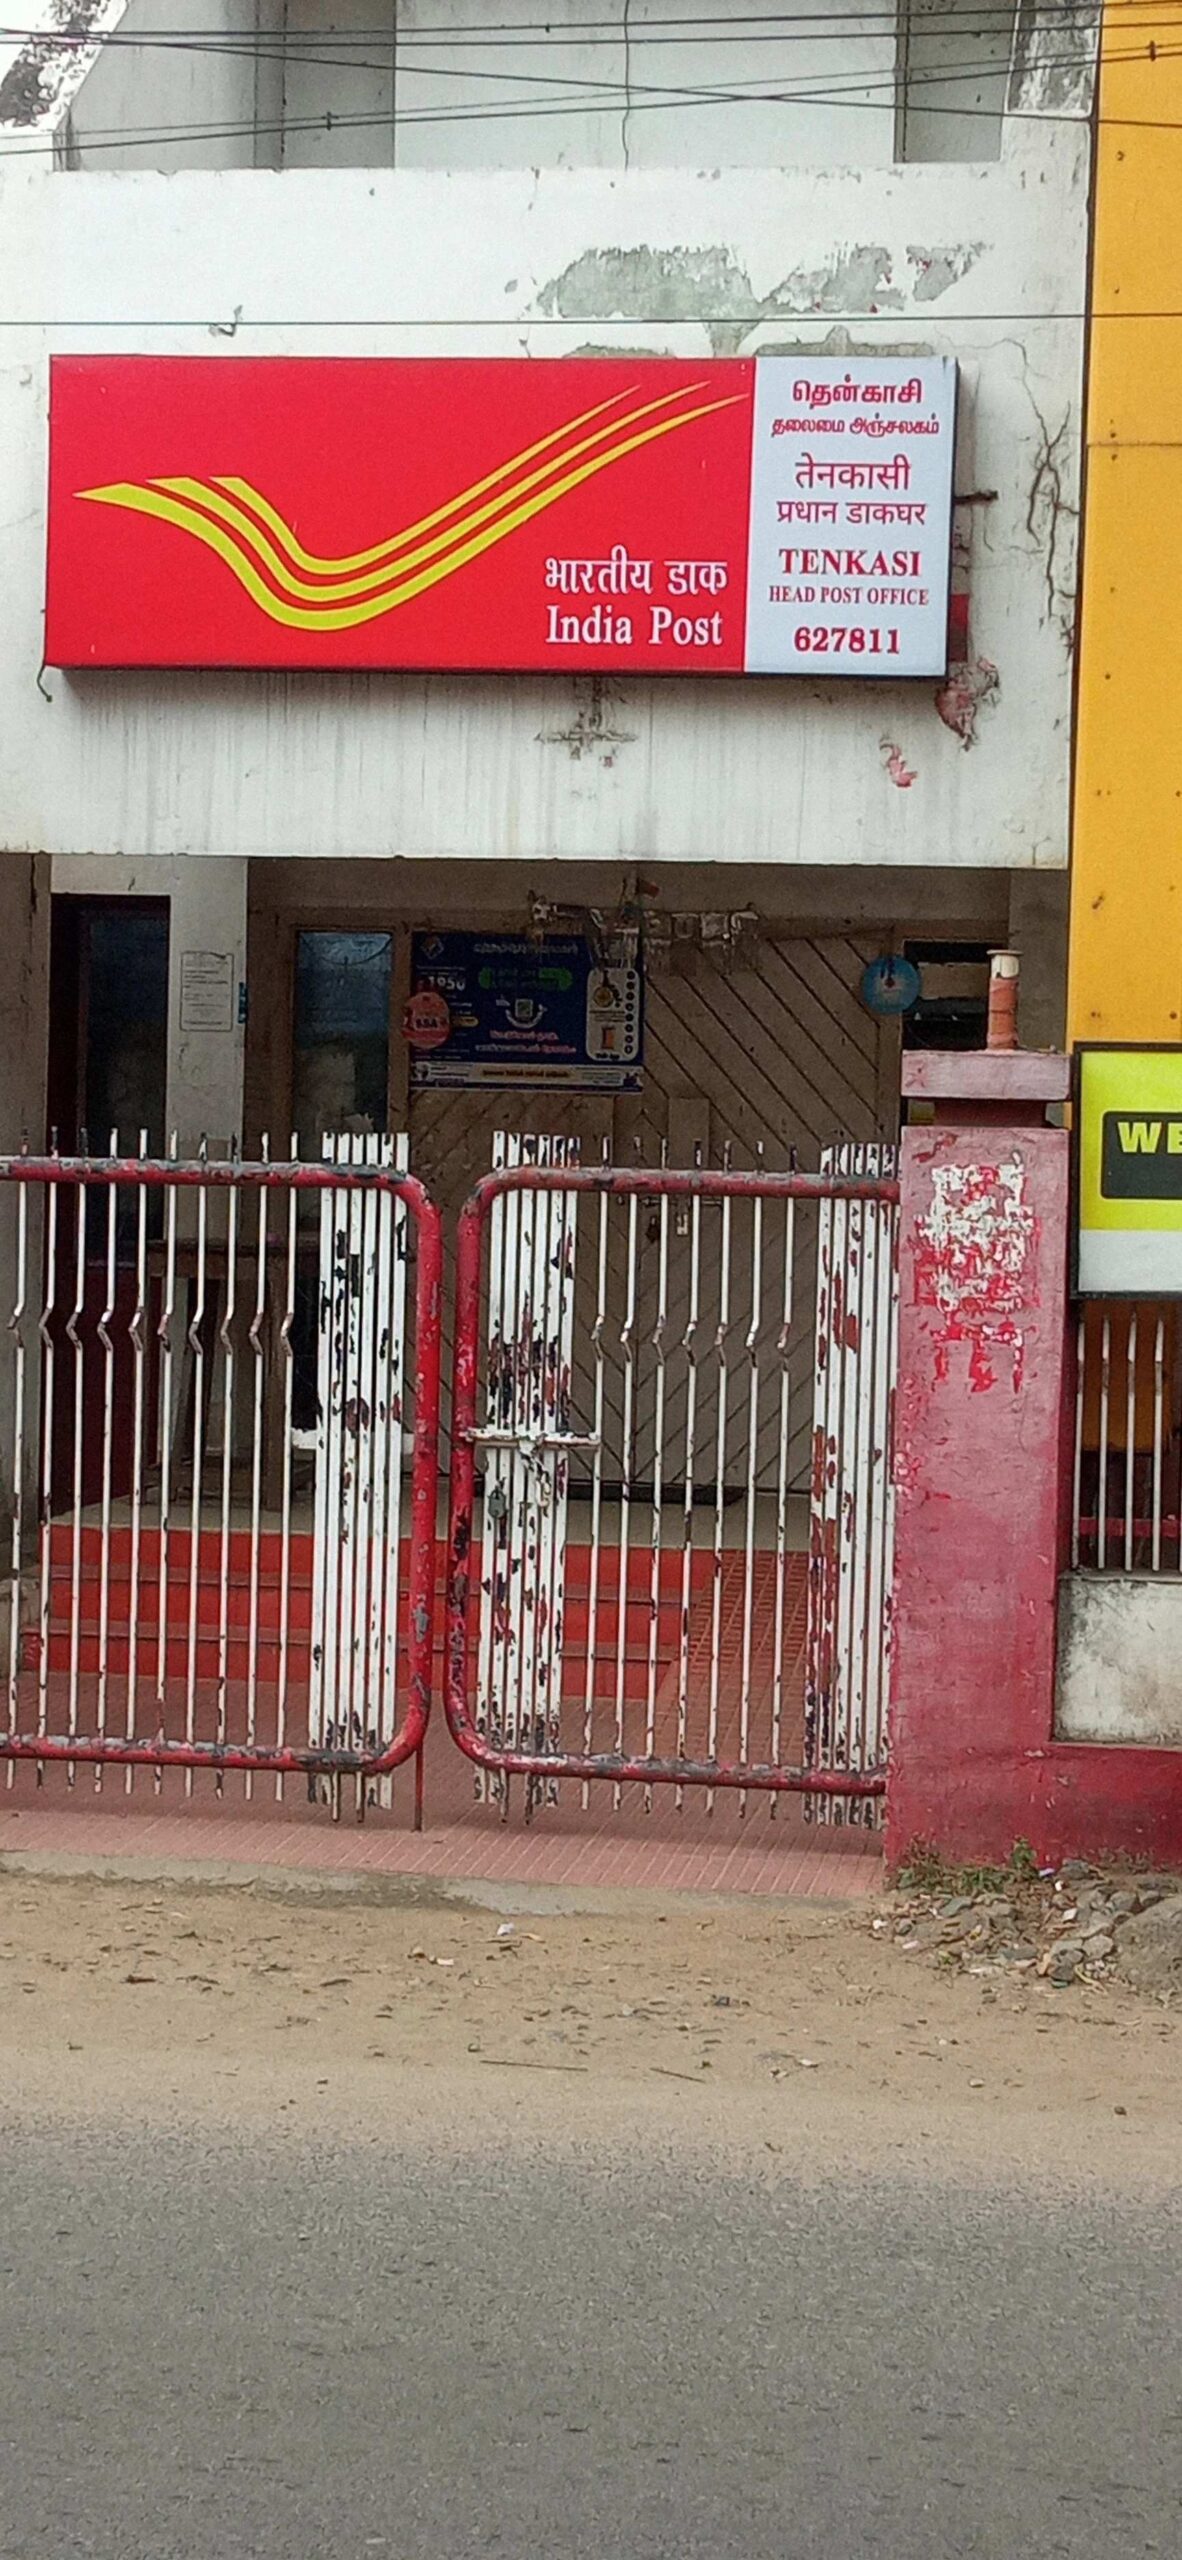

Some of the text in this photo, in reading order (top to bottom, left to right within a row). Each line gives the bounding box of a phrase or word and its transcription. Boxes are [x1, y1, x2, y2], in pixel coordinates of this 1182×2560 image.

[793, 374, 922, 409] தென்காசி
[771, 412, 940, 438] தலைமை அஞ்சலகம்
[795, 452, 911, 490] तेनकासी
[777, 501, 926, 525] प्रधान डाकघर
[545, 544, 728, 595] भारतीय डाक
[779, 548, 921, 577] TENKASI
[769, 585, 929, 606] HEAD POST OFFICE
[546, 605, 723, 645] India Post
[794, 626, 900, 654] 627811
